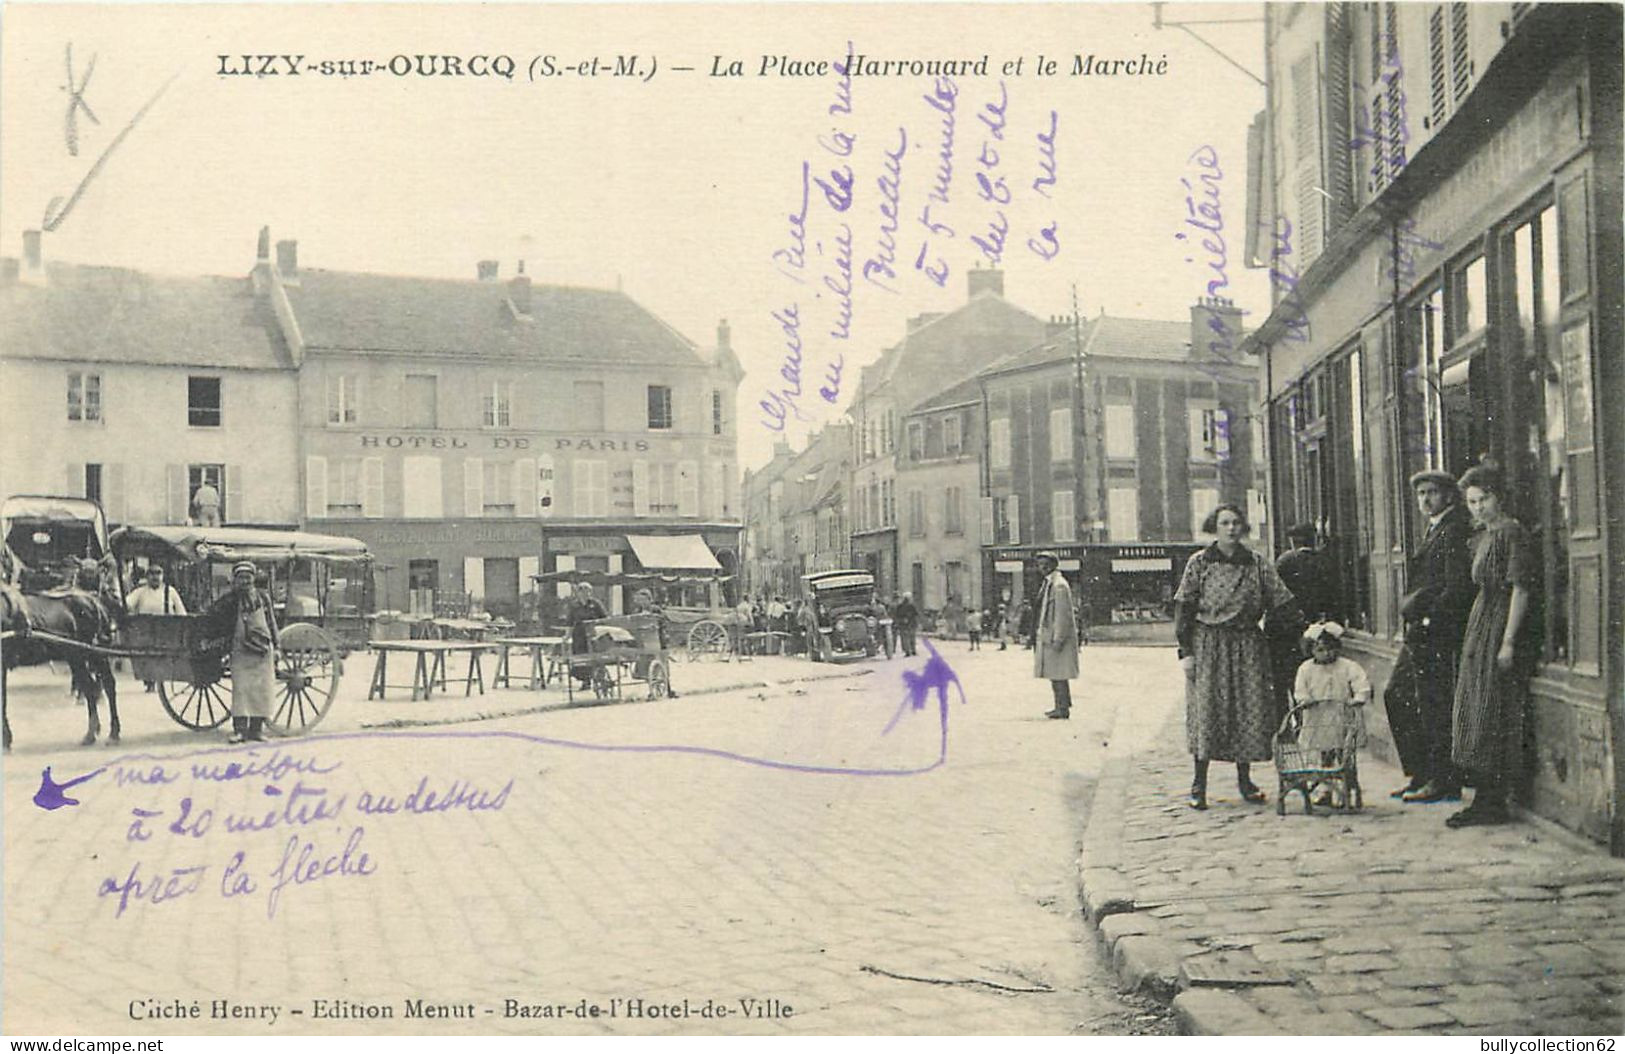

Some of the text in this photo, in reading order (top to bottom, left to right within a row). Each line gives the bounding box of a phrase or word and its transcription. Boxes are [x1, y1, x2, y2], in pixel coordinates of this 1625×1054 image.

[829, 40, 854, 115] rue
[977, 80, 1009, 140] de
[819, 127, 857, 157] la
[813, 164, 855, 213] de
[863, 127, 908, 294] Bureau
[1028, 110, 1060, 261] la rue
[773, 161, 810, 283] Rue
[919, 206, 956, 238] 5
[970, 211, 1009, 263] du
[820, 353, 844, 404] au
[361, 436, 650, 452] HOTEL DE PARIS
[113, 750, 344, 789] ma maison
[125, 807, 164, 842] à
[169, 797, 213, 838] 20
[220, 851, 257, 898] la
